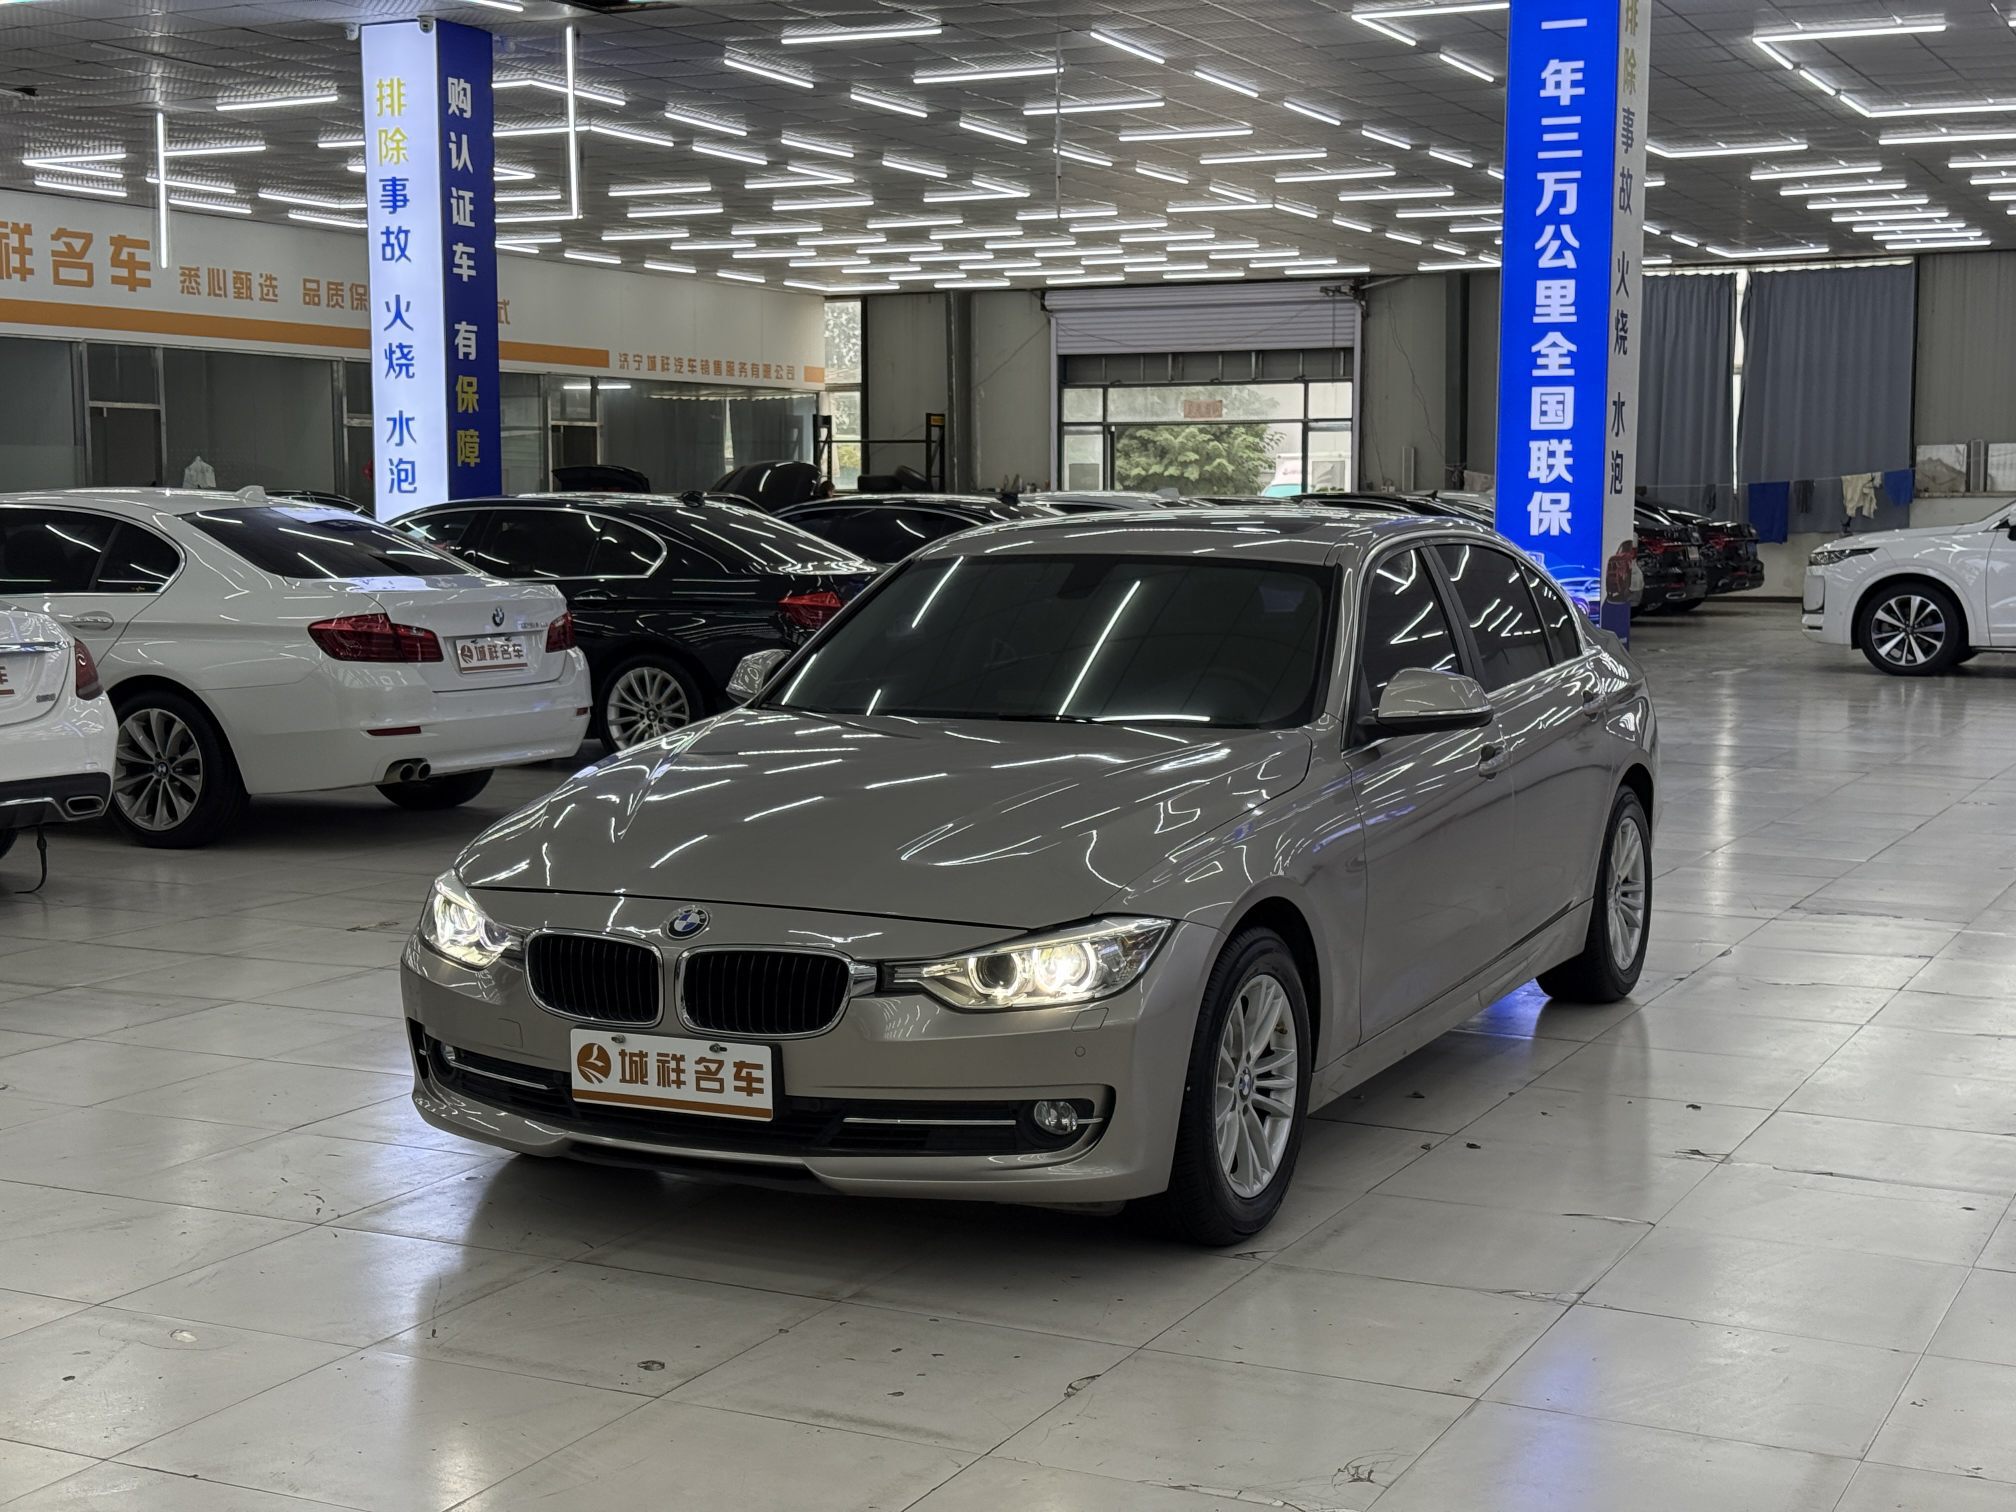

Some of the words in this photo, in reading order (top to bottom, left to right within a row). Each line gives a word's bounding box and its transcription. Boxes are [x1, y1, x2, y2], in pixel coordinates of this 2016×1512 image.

[1618, 0, 1638, 216] 排除事故
[376, 77, 412, 264] 排除事故
[447, 77, 477, 283] 购认证车
[0, 221, 151, 292] 祥名车
[179, 266, 279, 303] 悉心甄选
[302, 277, 368, 312] 品质保
[1527, 17, 1588, 537] 一年三万公里全国联保
[1613, 250, 1630, 355] 火烧
[384, 294, 415, 380] 火烧
[454, 321, 481, 468] 有保障
[1609, 391, 1626, 495] 水泡
[386, 410, 418, 495] 水泡
[618, 1049, 764, 1097] 城祥名车
